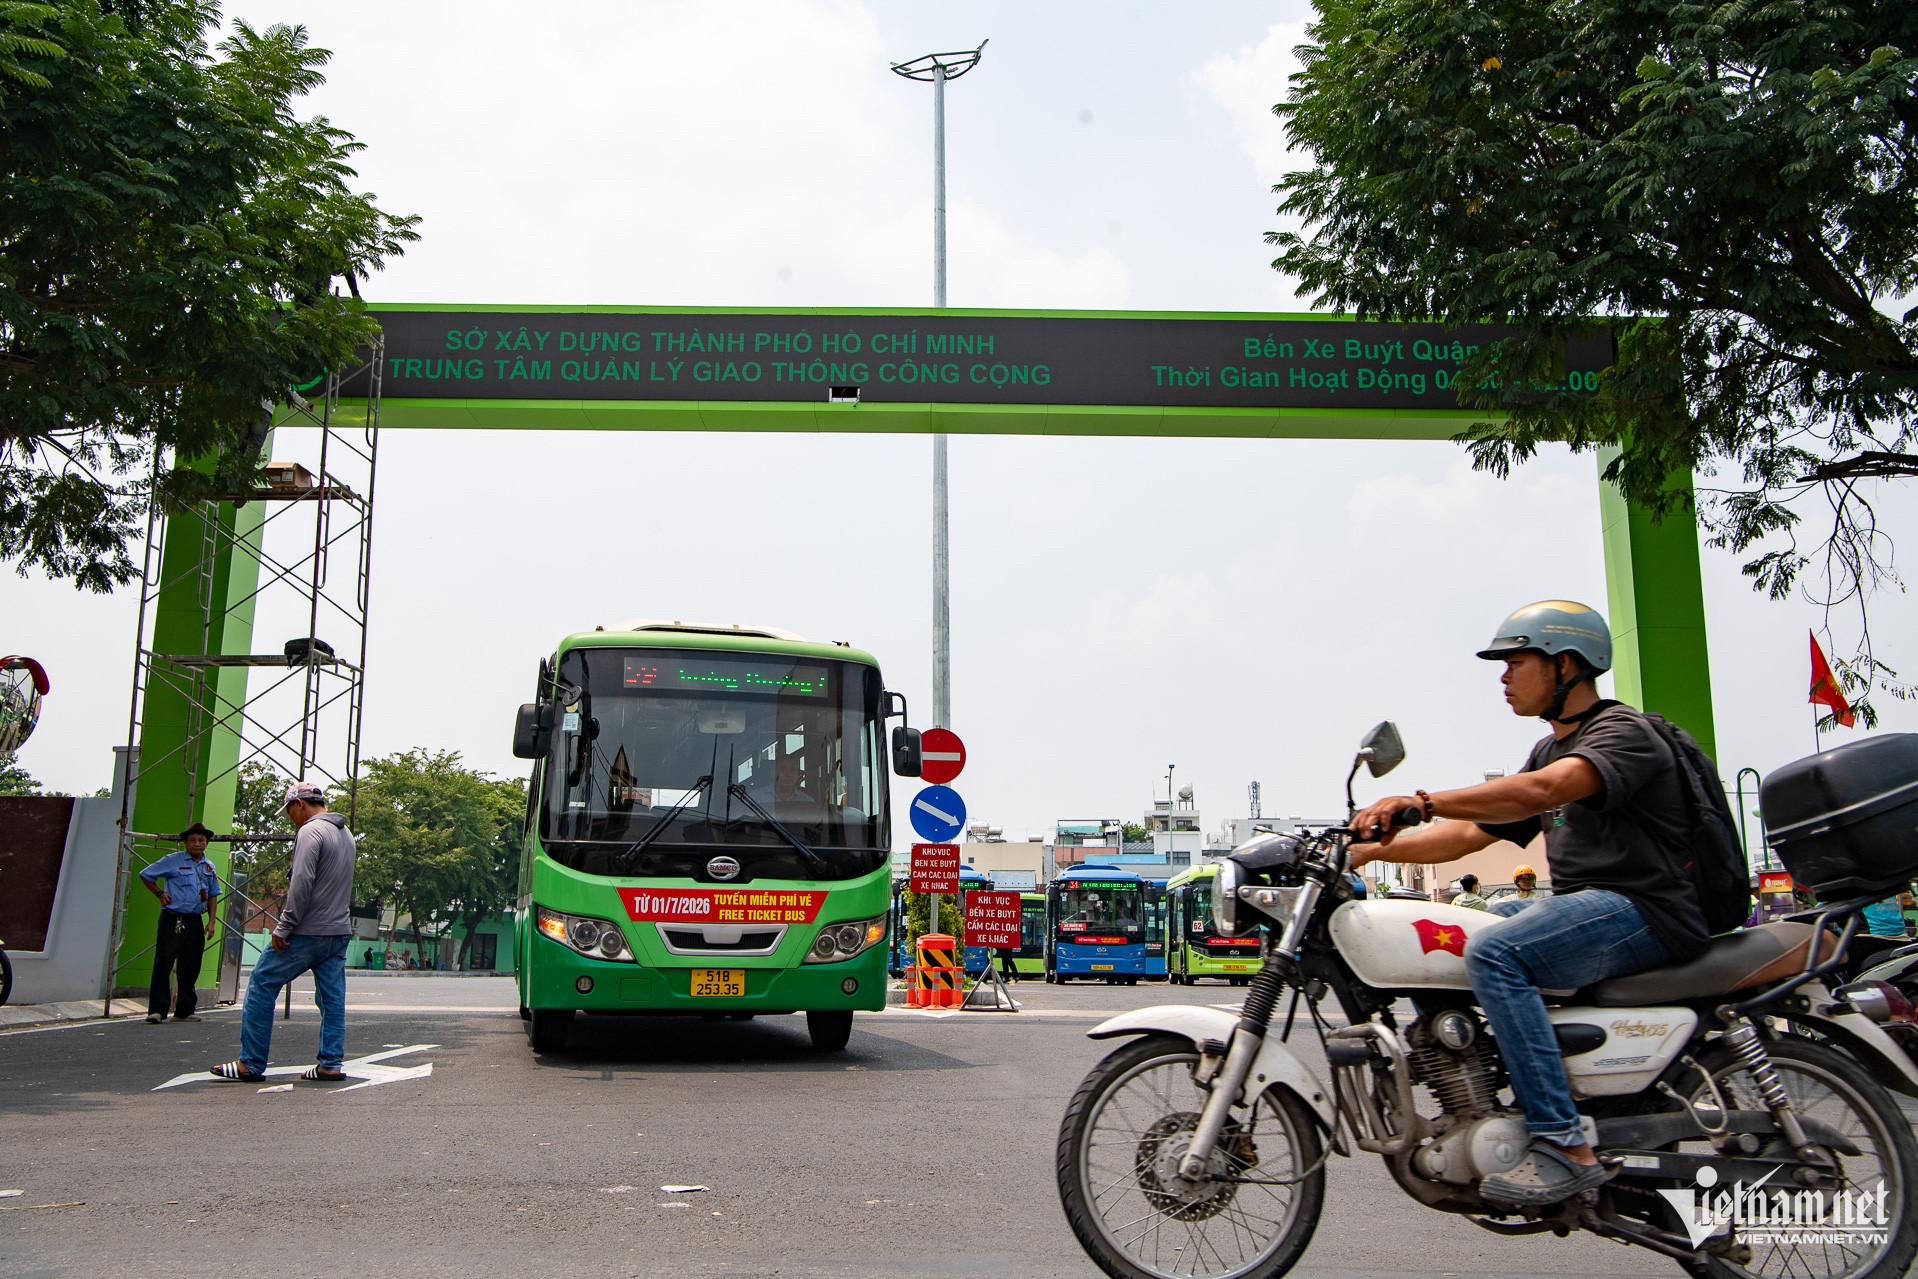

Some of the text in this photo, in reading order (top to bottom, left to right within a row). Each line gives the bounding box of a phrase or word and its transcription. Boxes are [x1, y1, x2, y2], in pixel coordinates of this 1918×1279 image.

[445, 325, 489, 351] SỞ
[495, 326, 551, 351] XÂY
[559, 331, 641, 357] DỰNG
[650, 327, 745, 353] THÀNH
[870, 329, 917, 354] CHÍ
[926, 333, 995, 355] MINH
[1243, 333, 1294, 359] Bến
[1303, 338, 1336, 360] Xe
[1343, 338, 1405, 366] Buýt
[388, 358, 485, 380] TRUNG
[494, 355, 551, 381] TÂM
[560, 356, 641, 382] QUẢN
[650, 357, 685, 382] LÝ
[692, 360, 763, 383] GIAO
[771, 357, 870, 383] THÔNG
[878, 358, 961, 385] CÔNG
[1151, 364, 1211, 388] Thời
[1219, 365, 1280, 388] Gian
[1288, 367, 1349, 394] Hoạt
[1356, 367, 1427, 396] Động
[709, 863, 738, 872] SAMCO
[930, 859, 939, 868] XE
[920, 881, 930, 890] XE
[634, 893, 711, 915] TỪ 01/7/2026
[713, 891, 812, 907] TUYẾN MIỄN PHÍ VÉ
[719, 909, 806, 922] FREE TICKET BUS
[985, 909, 996, 918] XE
[1193, 922, 1202, 930] 62
[977, 933, 987, 943] XE
[706, 970, 730, 982] 51B
[696, 983, 739, 996] 253.35
